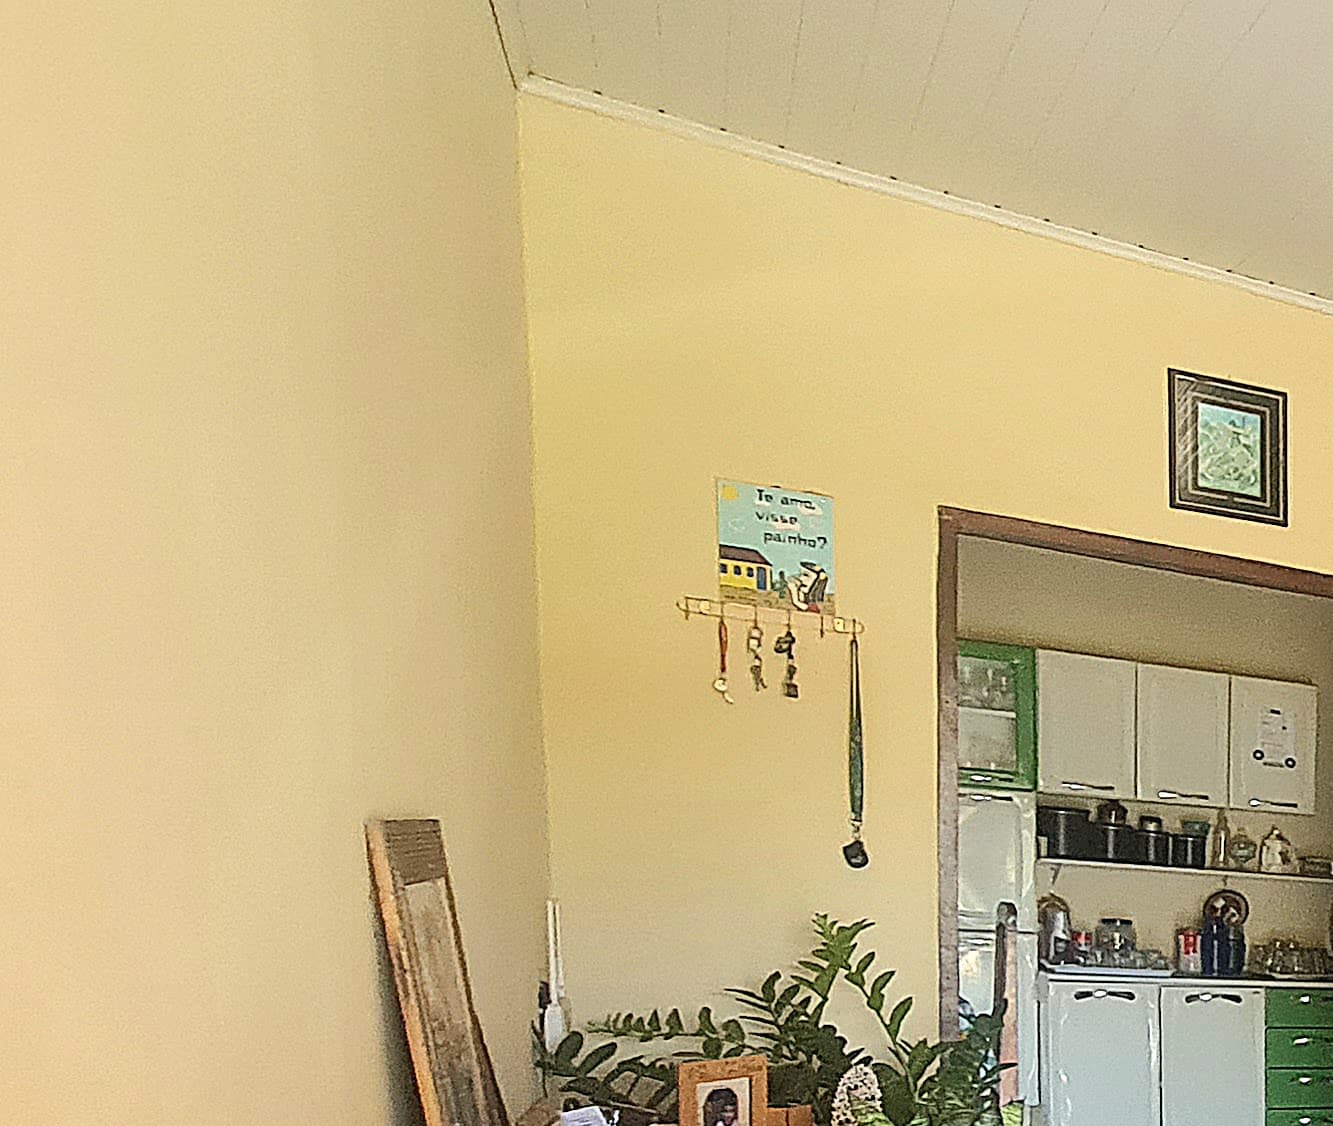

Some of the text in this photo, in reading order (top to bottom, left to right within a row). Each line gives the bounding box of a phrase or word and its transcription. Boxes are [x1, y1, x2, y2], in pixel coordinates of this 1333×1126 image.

[756, 488, 774, 503] Te
[755, 510, 798, 526] visse
[763, 531, 828, 550] painho?
